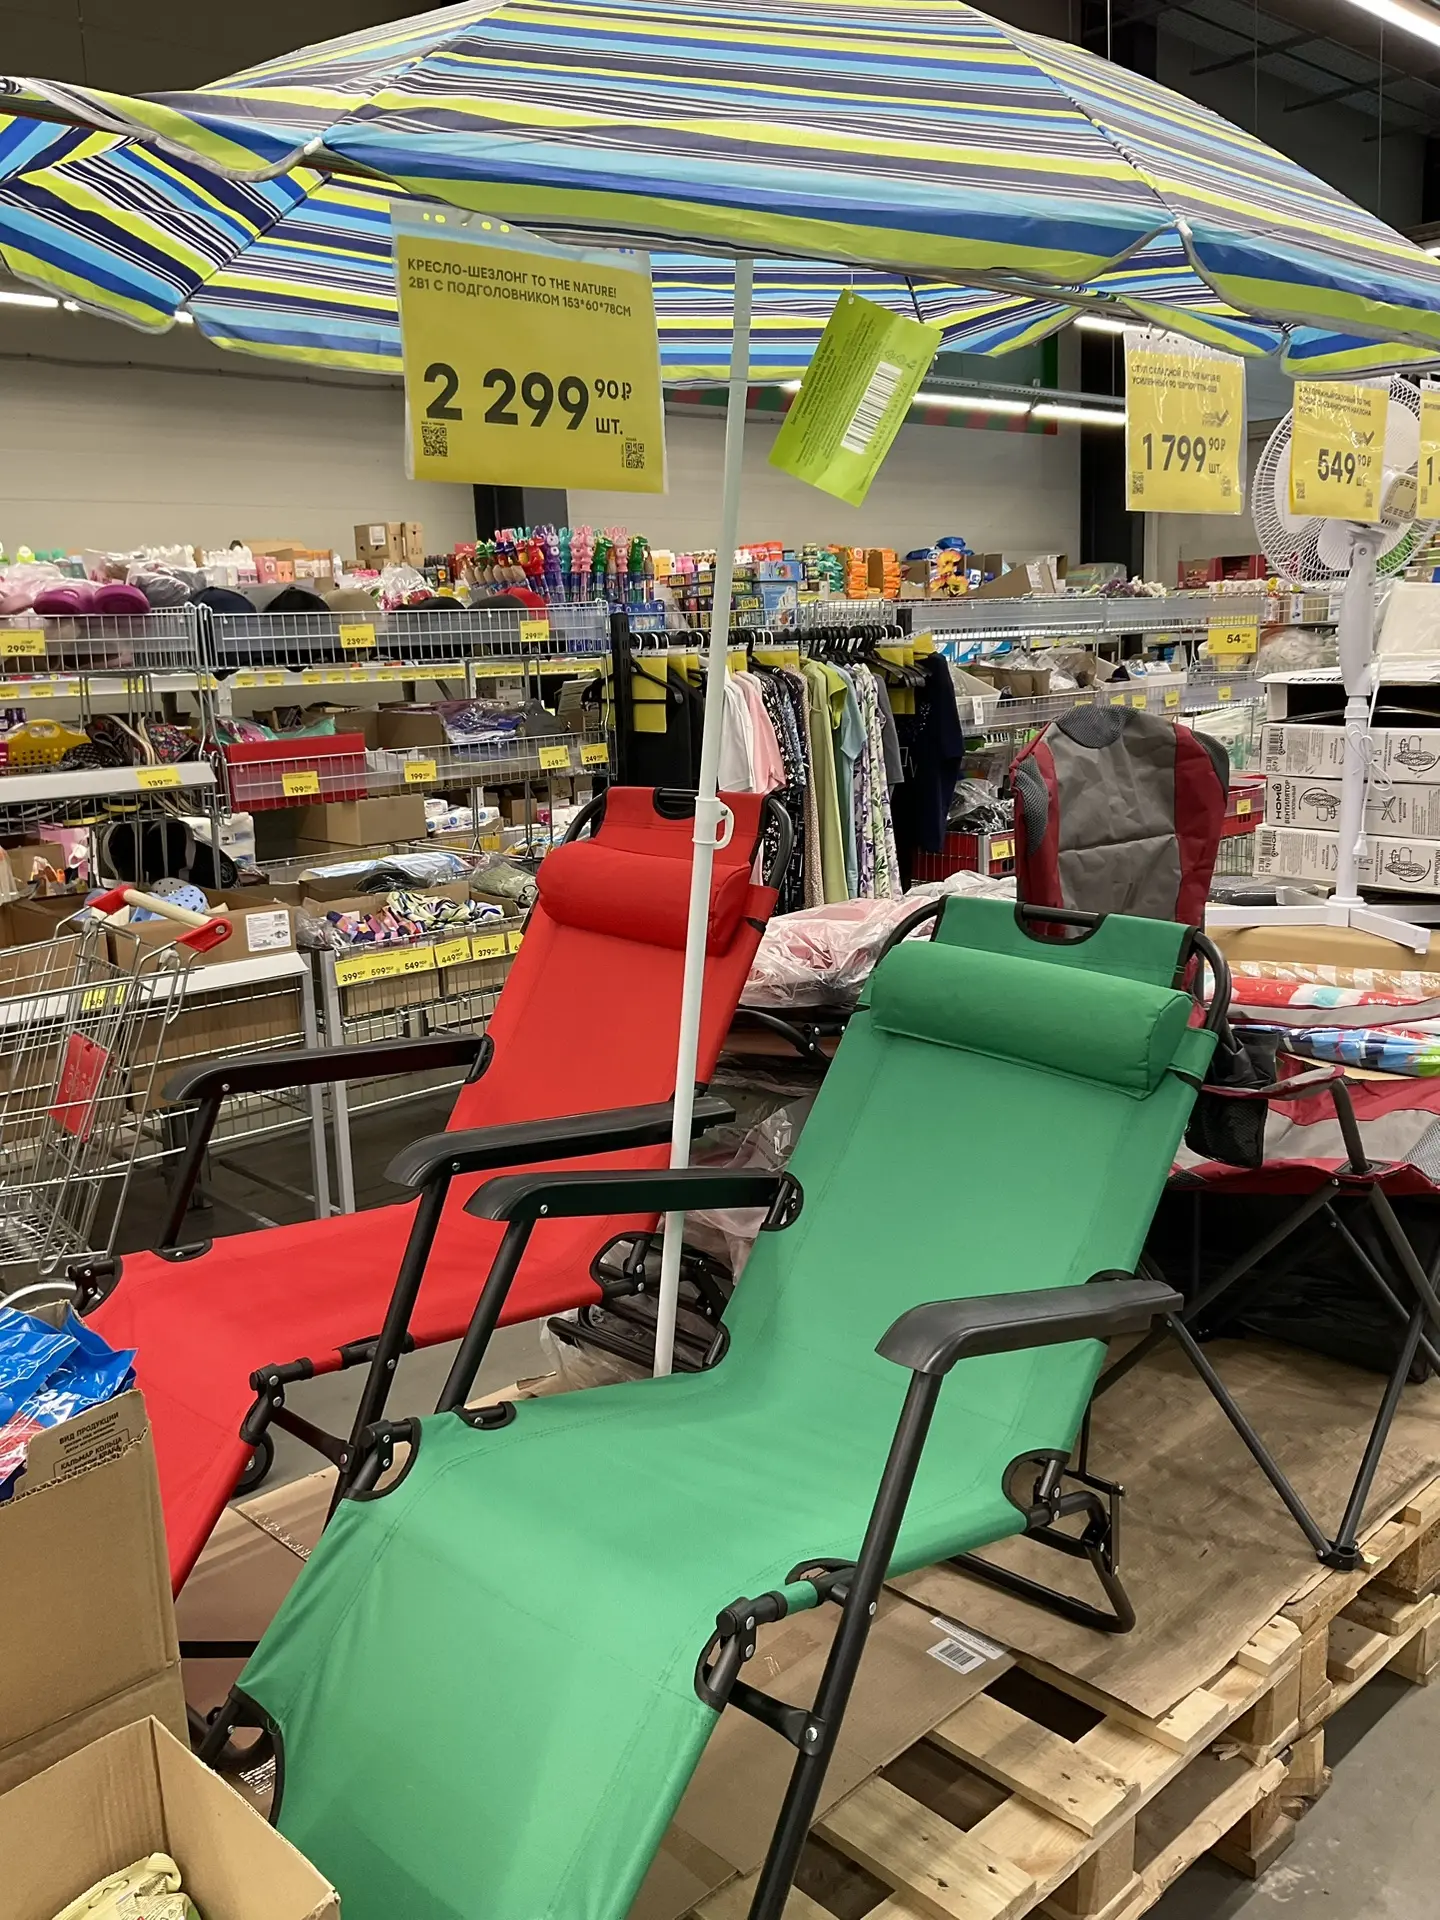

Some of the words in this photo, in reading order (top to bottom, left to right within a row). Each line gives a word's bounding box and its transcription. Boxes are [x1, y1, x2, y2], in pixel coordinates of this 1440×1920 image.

[407, 257, 529, 285] КРЕСЛО-ШЕЗЛОНГ
[531, 274, 547, 288] TO
[549, 277, 571, 292] THE
[573, 281, 617, 299] NATURE!
[447, 280, 560, 307] ПОДГОЛОВНИКОМ
[423, 362, 463, 421] 2
[482, 367, 590, 431] 299
[595, 416, 624, 435] ШТ.
[1142, 433, 1153, 471] 1
[1161, 434, 1207, 473] 799
[1317, 448, 1356, 485] 549
[7, 644, 26, 653] 299
[1226, 633, 1241, 644] 54
[59, 1432, 75, 1445] ВИД
[76, 1411, 119, 1437] ПРОДУКЦИИ
